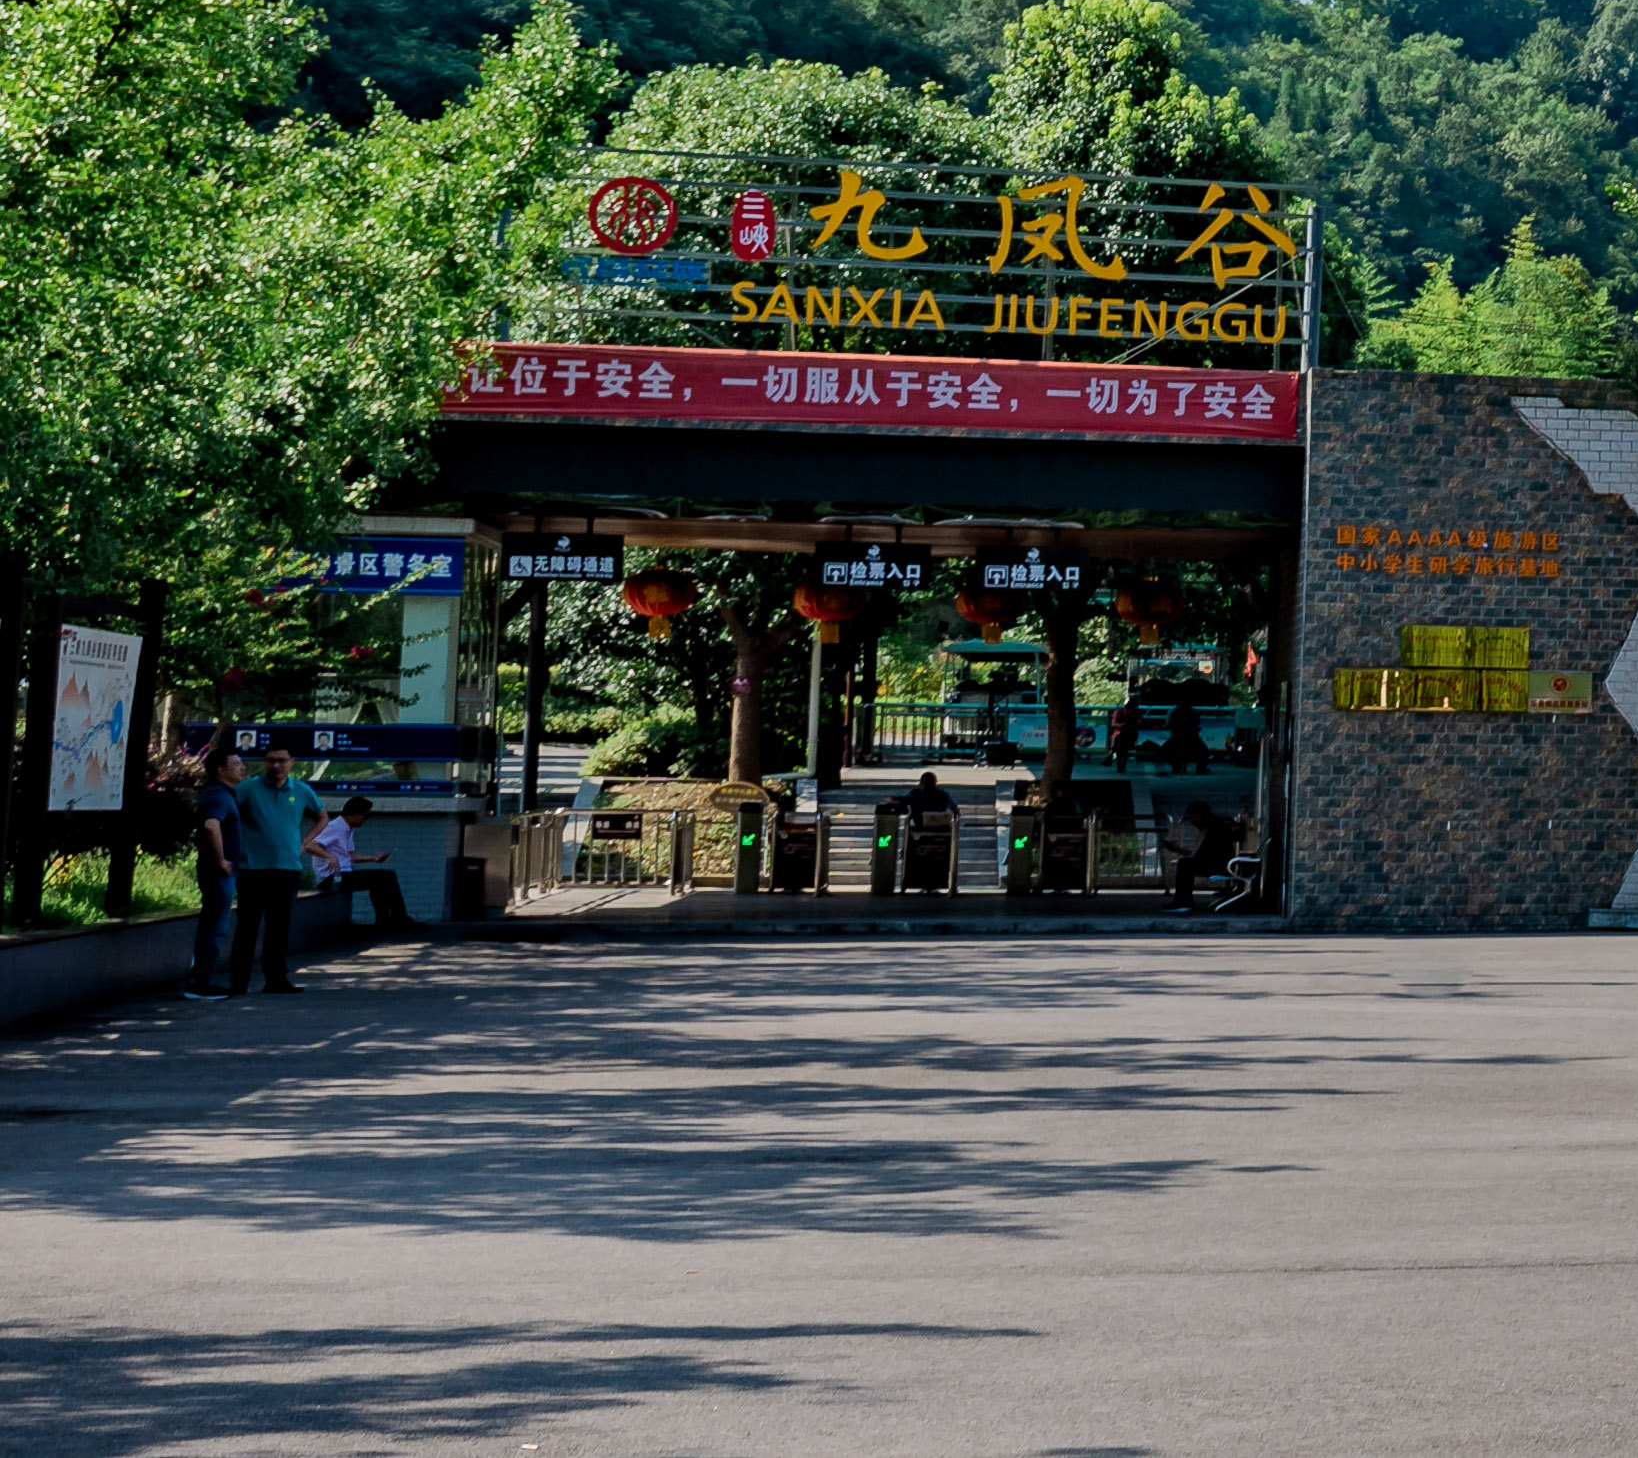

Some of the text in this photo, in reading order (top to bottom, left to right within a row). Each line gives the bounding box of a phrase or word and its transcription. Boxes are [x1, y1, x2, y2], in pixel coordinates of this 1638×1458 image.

[739, 196, 769, 255] 三峡
[808, 170, 1297, 291] 九凤谷
[731, 281, 1288, 344] SANXIA JIUFENGGU
[442, 355, 1277, 421] 让位于安全，一切服从于安全，一切为了安全
[322, 551, 454, 580] 景区警务室
[849, 561, 922, 580] 检票入口
[1010, 563, 1080, 582] 检票入口
